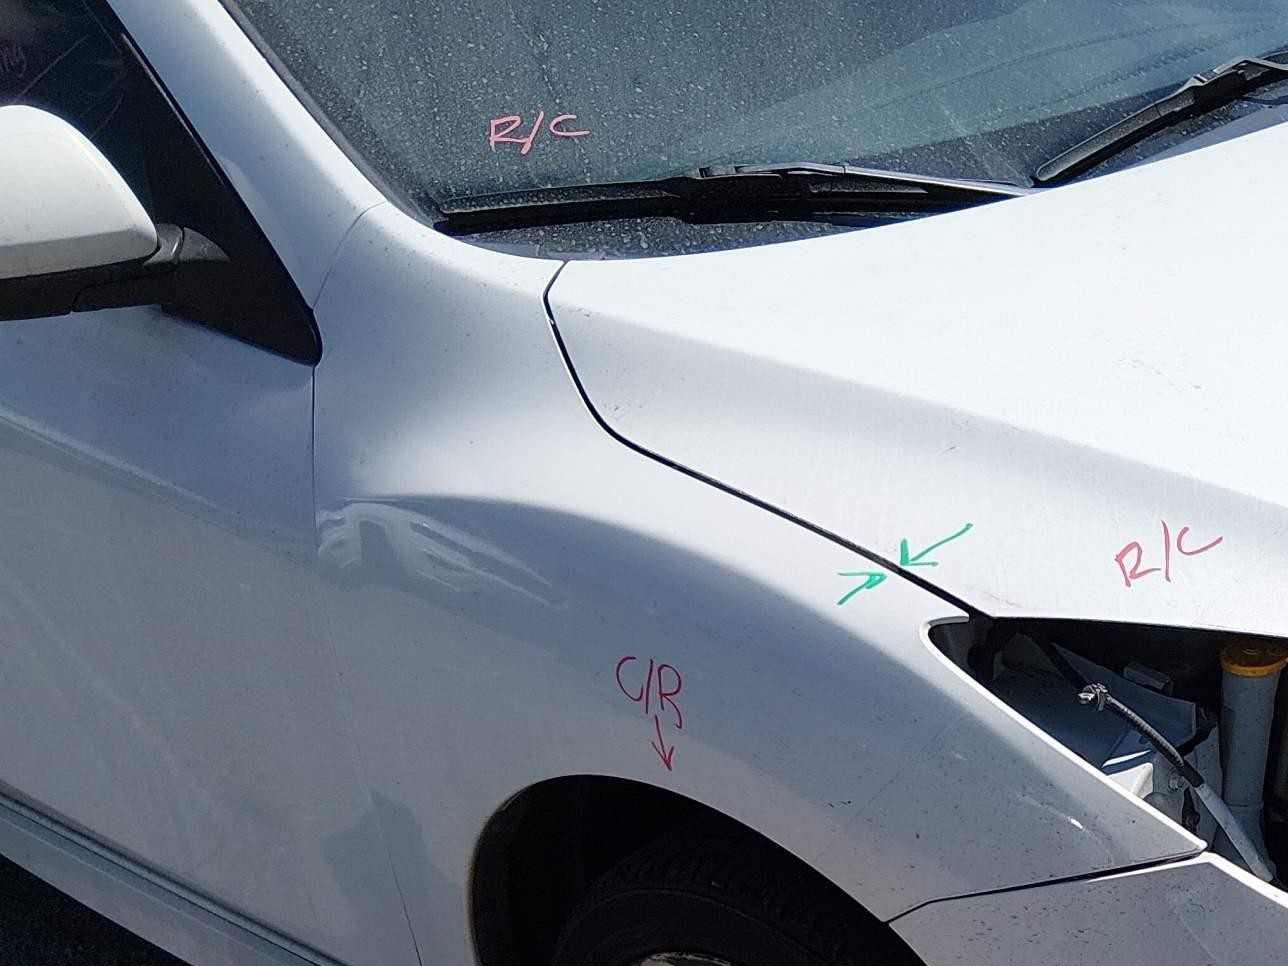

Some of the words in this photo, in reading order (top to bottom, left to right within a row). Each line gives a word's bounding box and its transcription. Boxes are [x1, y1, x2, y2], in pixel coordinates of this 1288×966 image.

[489, 110, 592, 154] R/C
[1114, 519, 1223, 588] R/C
[616, 656, 683, 729] C/R
